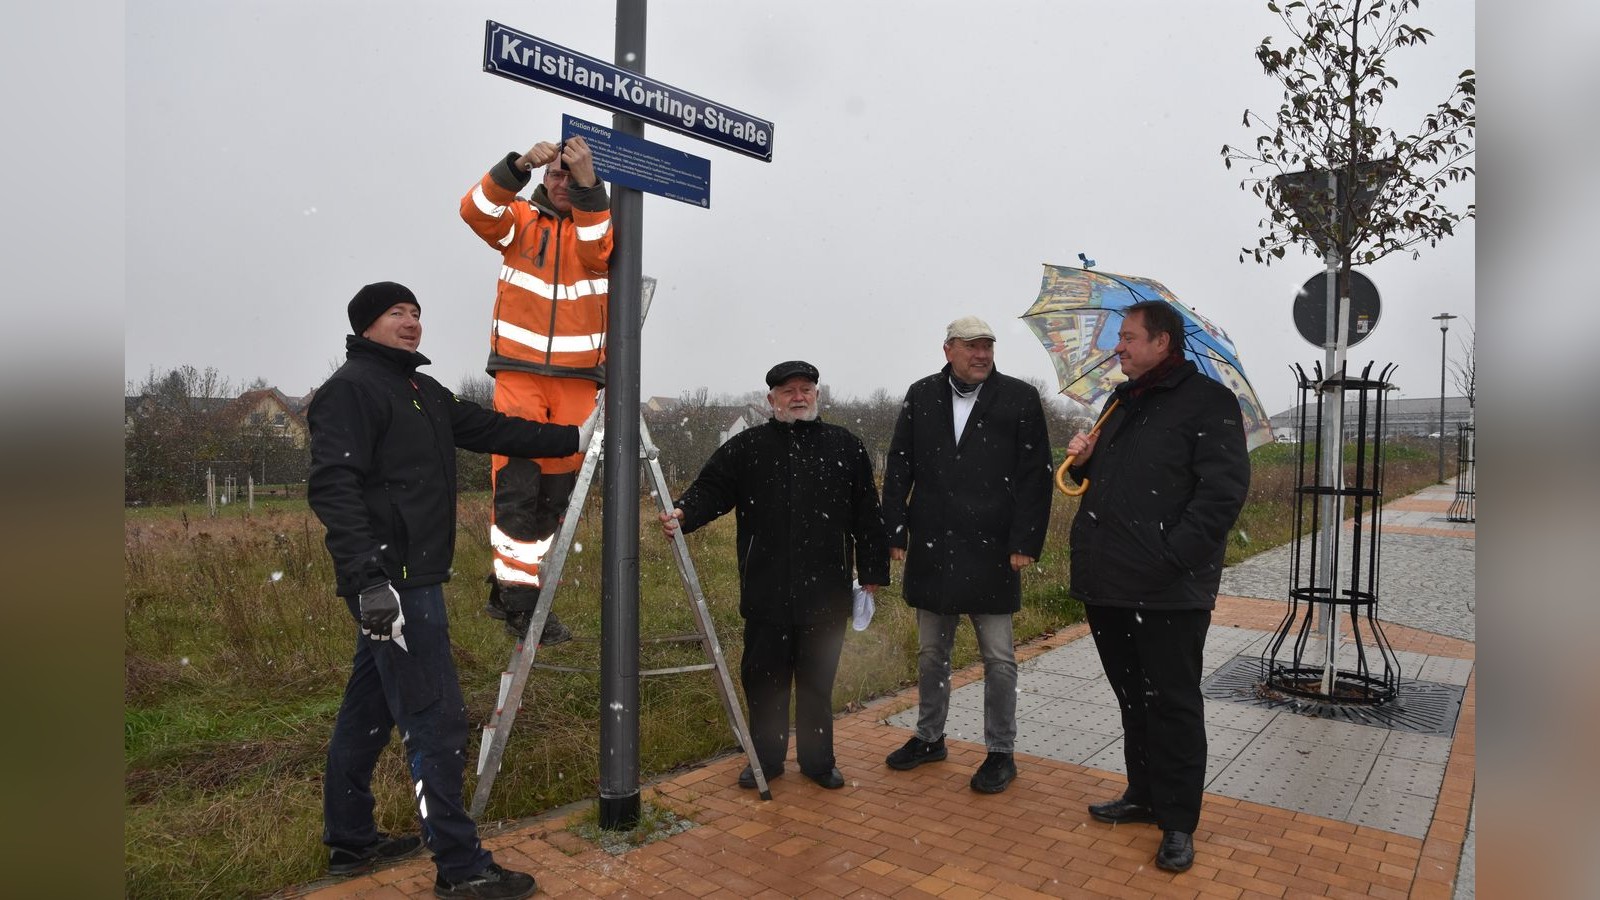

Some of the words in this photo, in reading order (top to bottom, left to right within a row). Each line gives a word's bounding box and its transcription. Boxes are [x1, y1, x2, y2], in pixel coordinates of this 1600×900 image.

[501, 34, 768, 147] Kristian-Körting-Straße
[569, 119, 591, 131] Kristian
[591, 125, 612, 139] Körting
